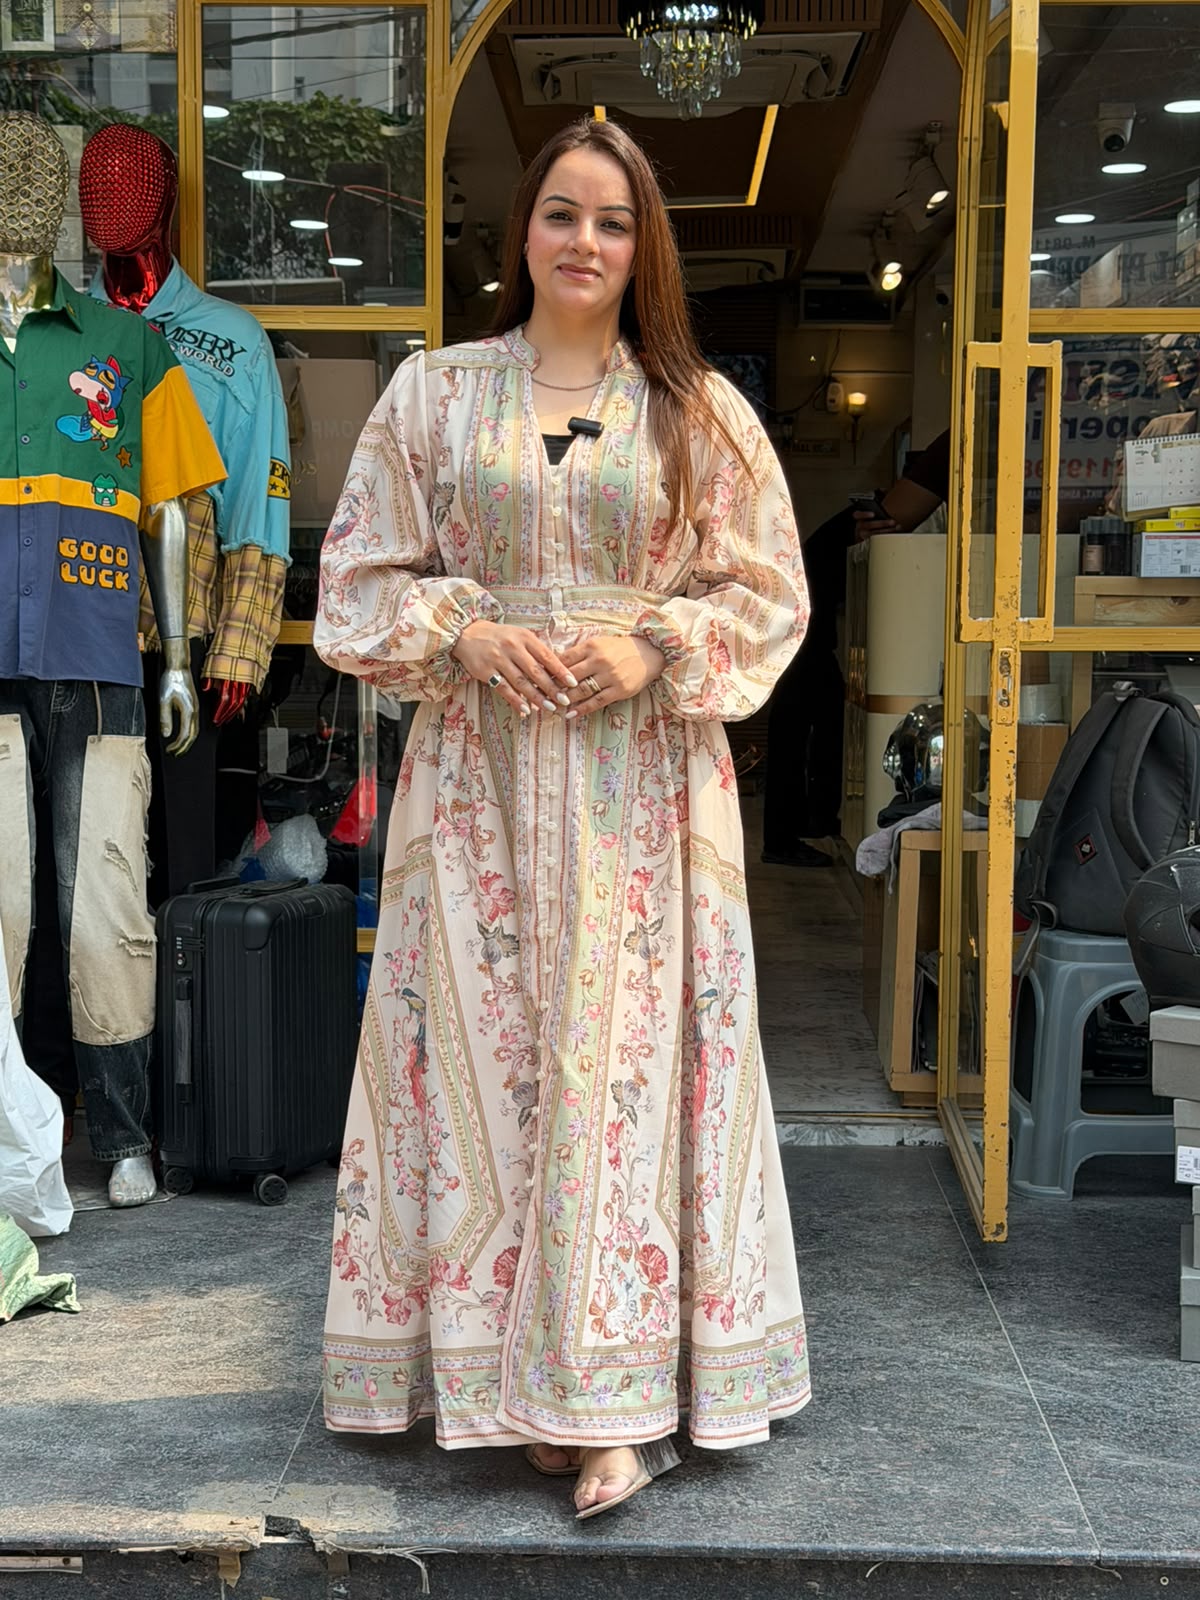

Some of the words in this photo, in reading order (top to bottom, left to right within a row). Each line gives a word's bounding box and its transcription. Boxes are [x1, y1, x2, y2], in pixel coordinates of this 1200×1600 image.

[158, 322, 248, 364] MISERY
[179, 344, 236, 378] WORLD
[57, 536, 130, 568] GOOD
[59, 561, 130, 592] LUCK
